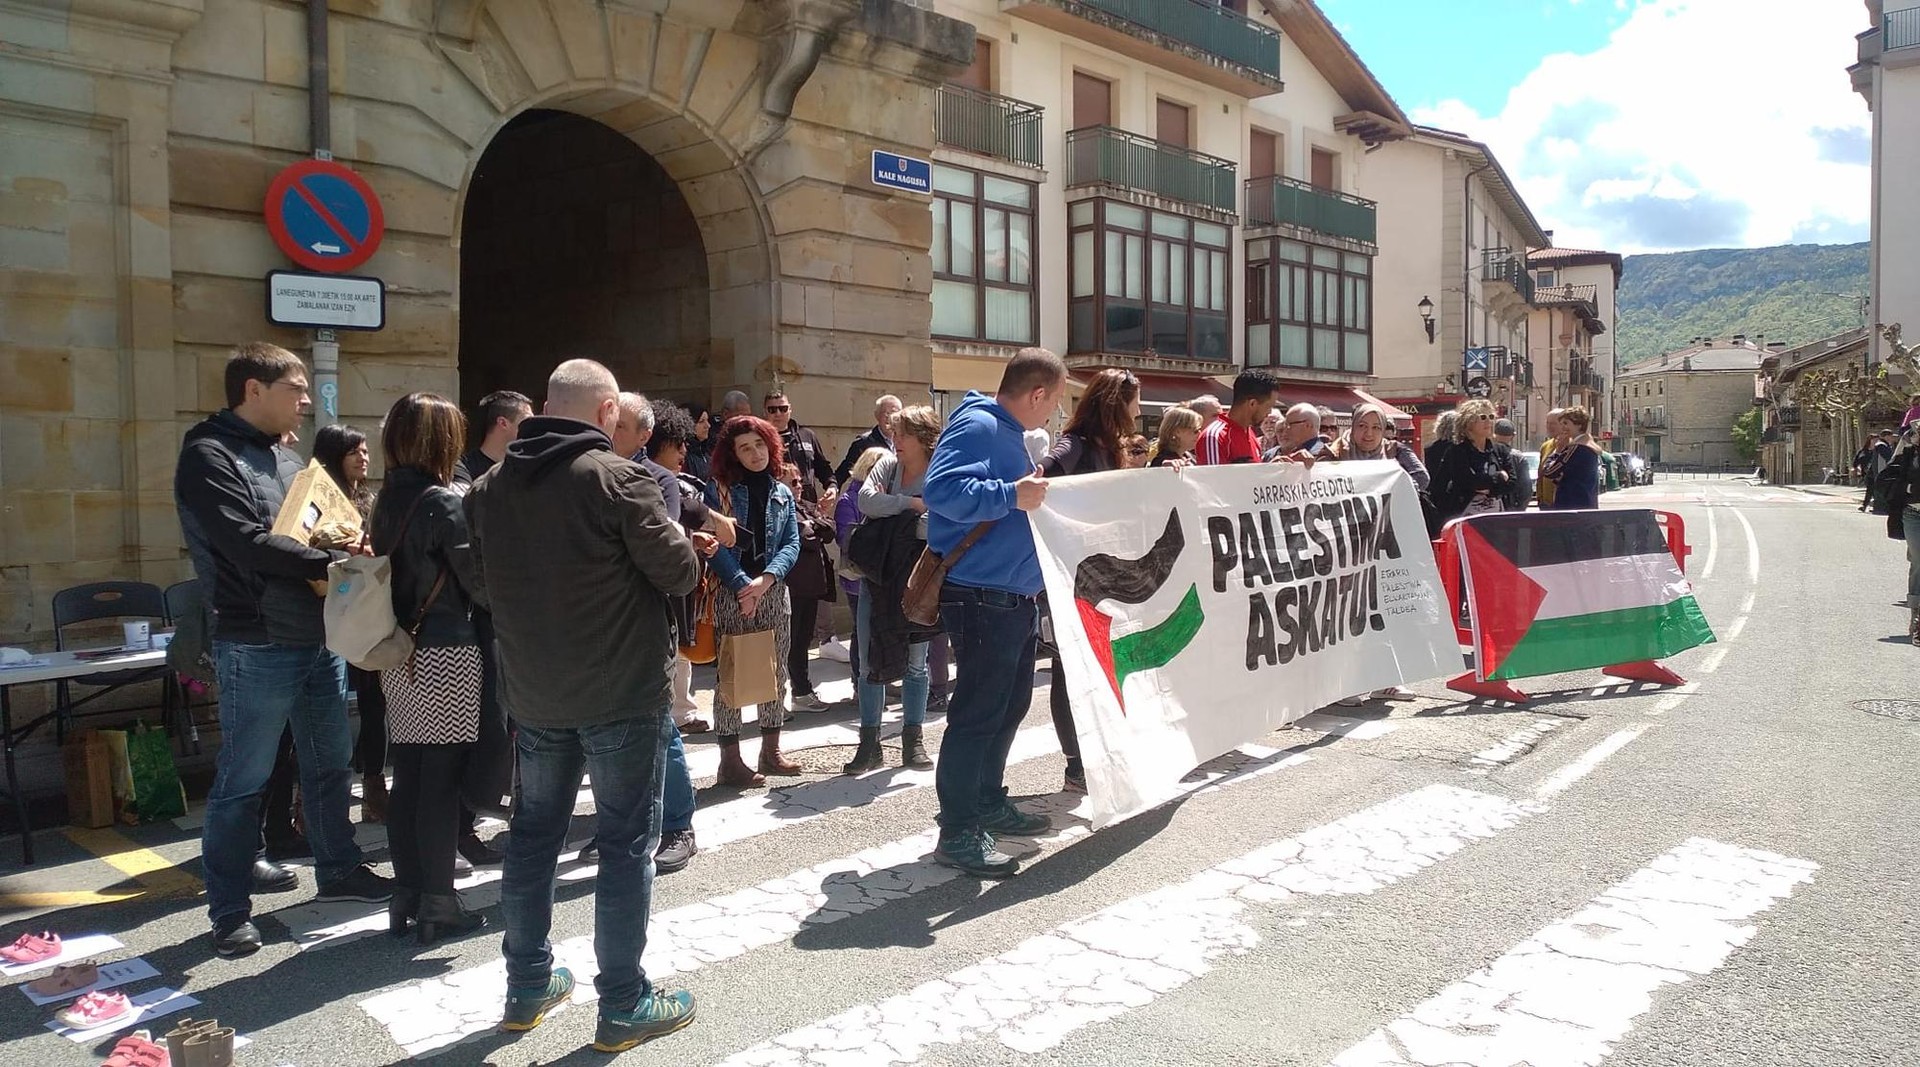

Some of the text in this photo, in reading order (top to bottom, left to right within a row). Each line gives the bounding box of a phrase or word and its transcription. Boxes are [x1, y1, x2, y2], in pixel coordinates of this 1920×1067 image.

[878, 170, 927, 187] KALE NAGUSIA
[1253, 476, 1355, 505] SARRASKIA GELDITU!
[1207, 493, 1402, 593] PALESTINA
[1245, 565, 1385, 671] ASKATU!
